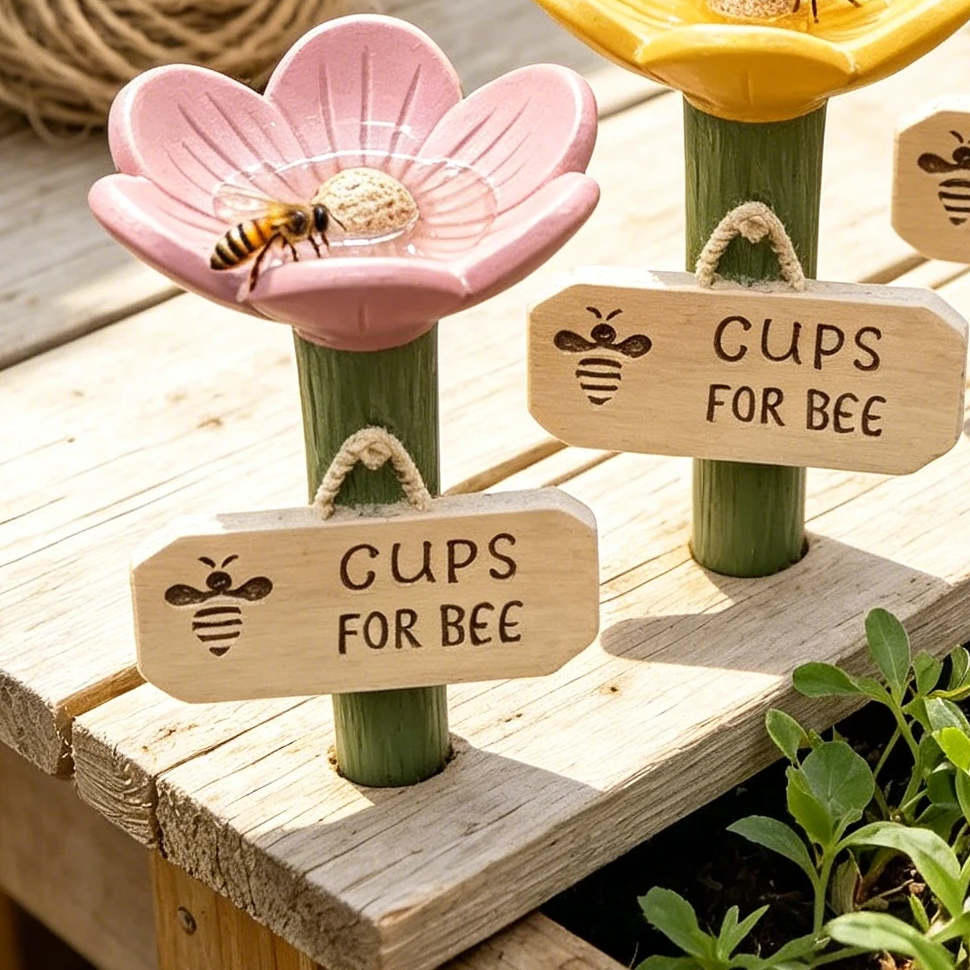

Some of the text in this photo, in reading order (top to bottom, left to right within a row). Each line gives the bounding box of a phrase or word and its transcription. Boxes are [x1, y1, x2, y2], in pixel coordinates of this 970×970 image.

[713, 315, 883, 373] CUPS
[706, 383, 888, 438] FOR BEE
[339, 532, 518, 592] CUPS
[338, 600, 525, 656] FOR BEE
